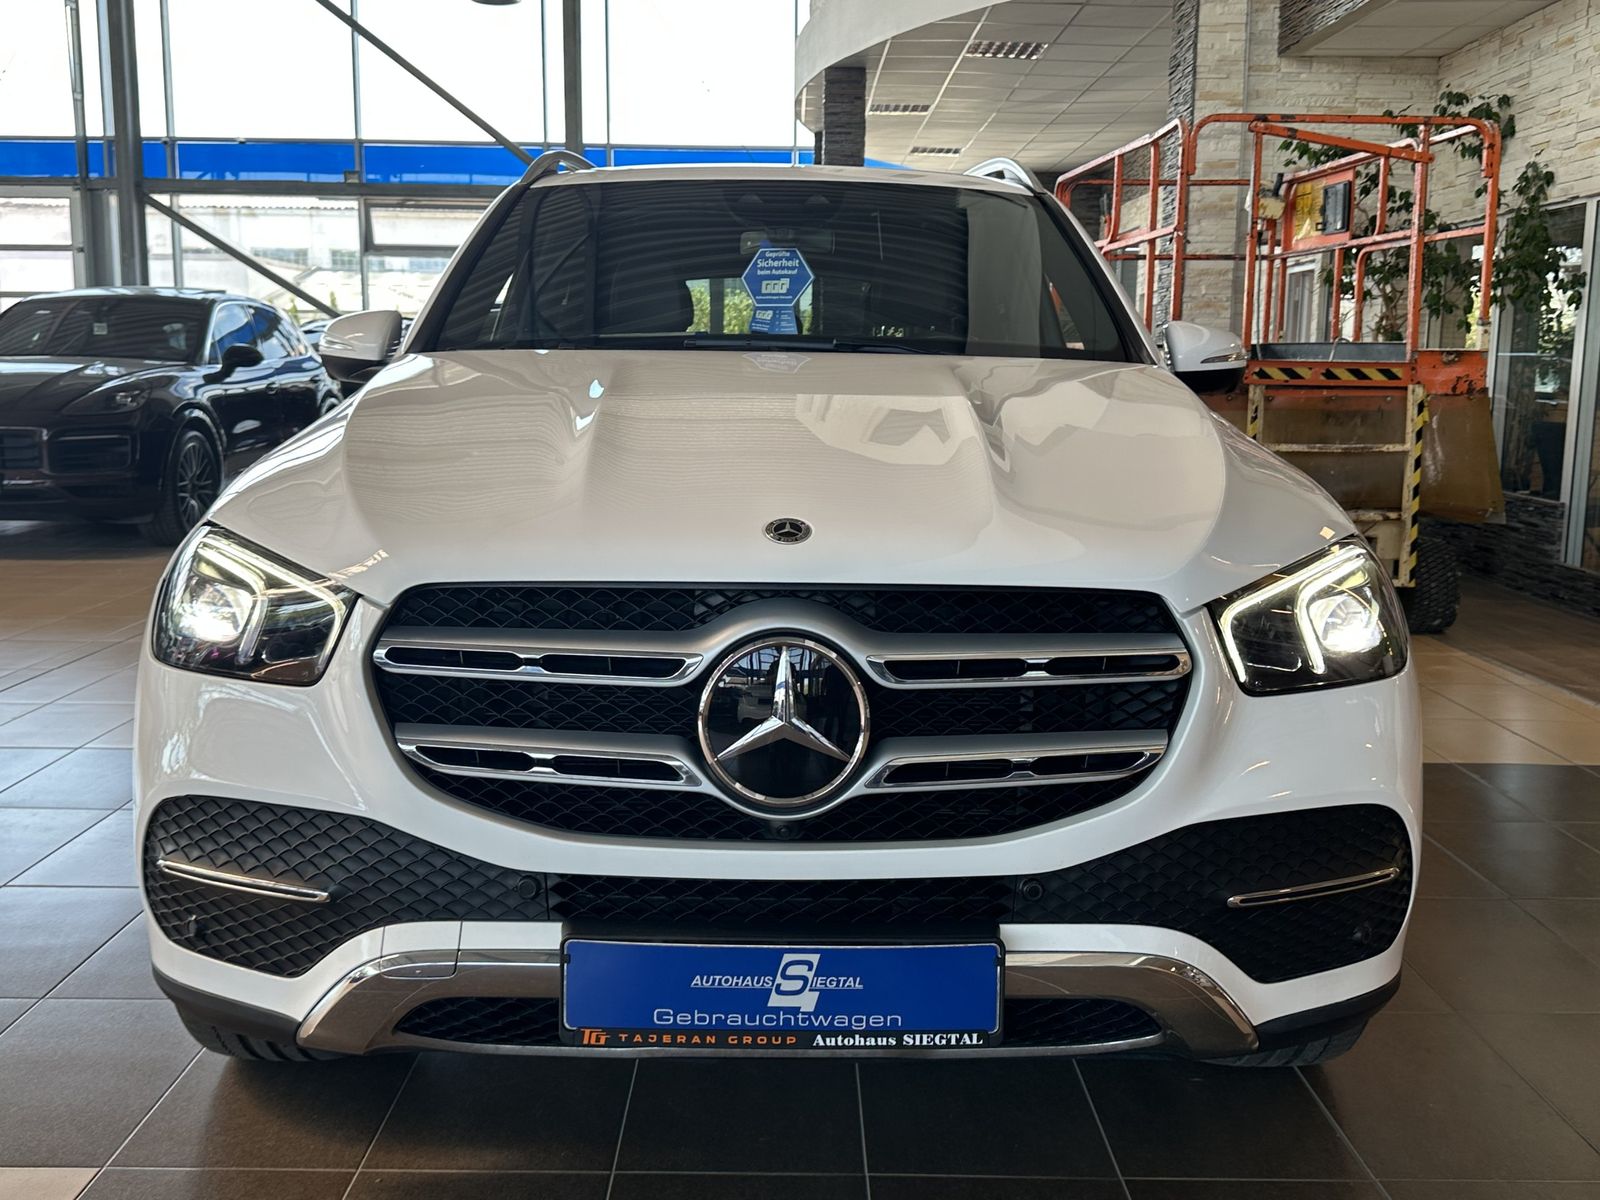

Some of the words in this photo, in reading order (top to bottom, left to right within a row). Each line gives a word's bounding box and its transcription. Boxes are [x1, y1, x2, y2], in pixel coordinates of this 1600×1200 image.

[757, 258, 800, 268] Sicherheit
[691, 975, 773, 988] AUTOHAUS
[653, 1008, 902, 1030] Gebrauchtwagen
[618, 1033, 716, 1044] TAJERAN
[727, 1035, 798, 1045] GROUP
[812, 1033, 897, 1047] Autohaus
[902, 1033, 984, 1046] SIEGTAL
